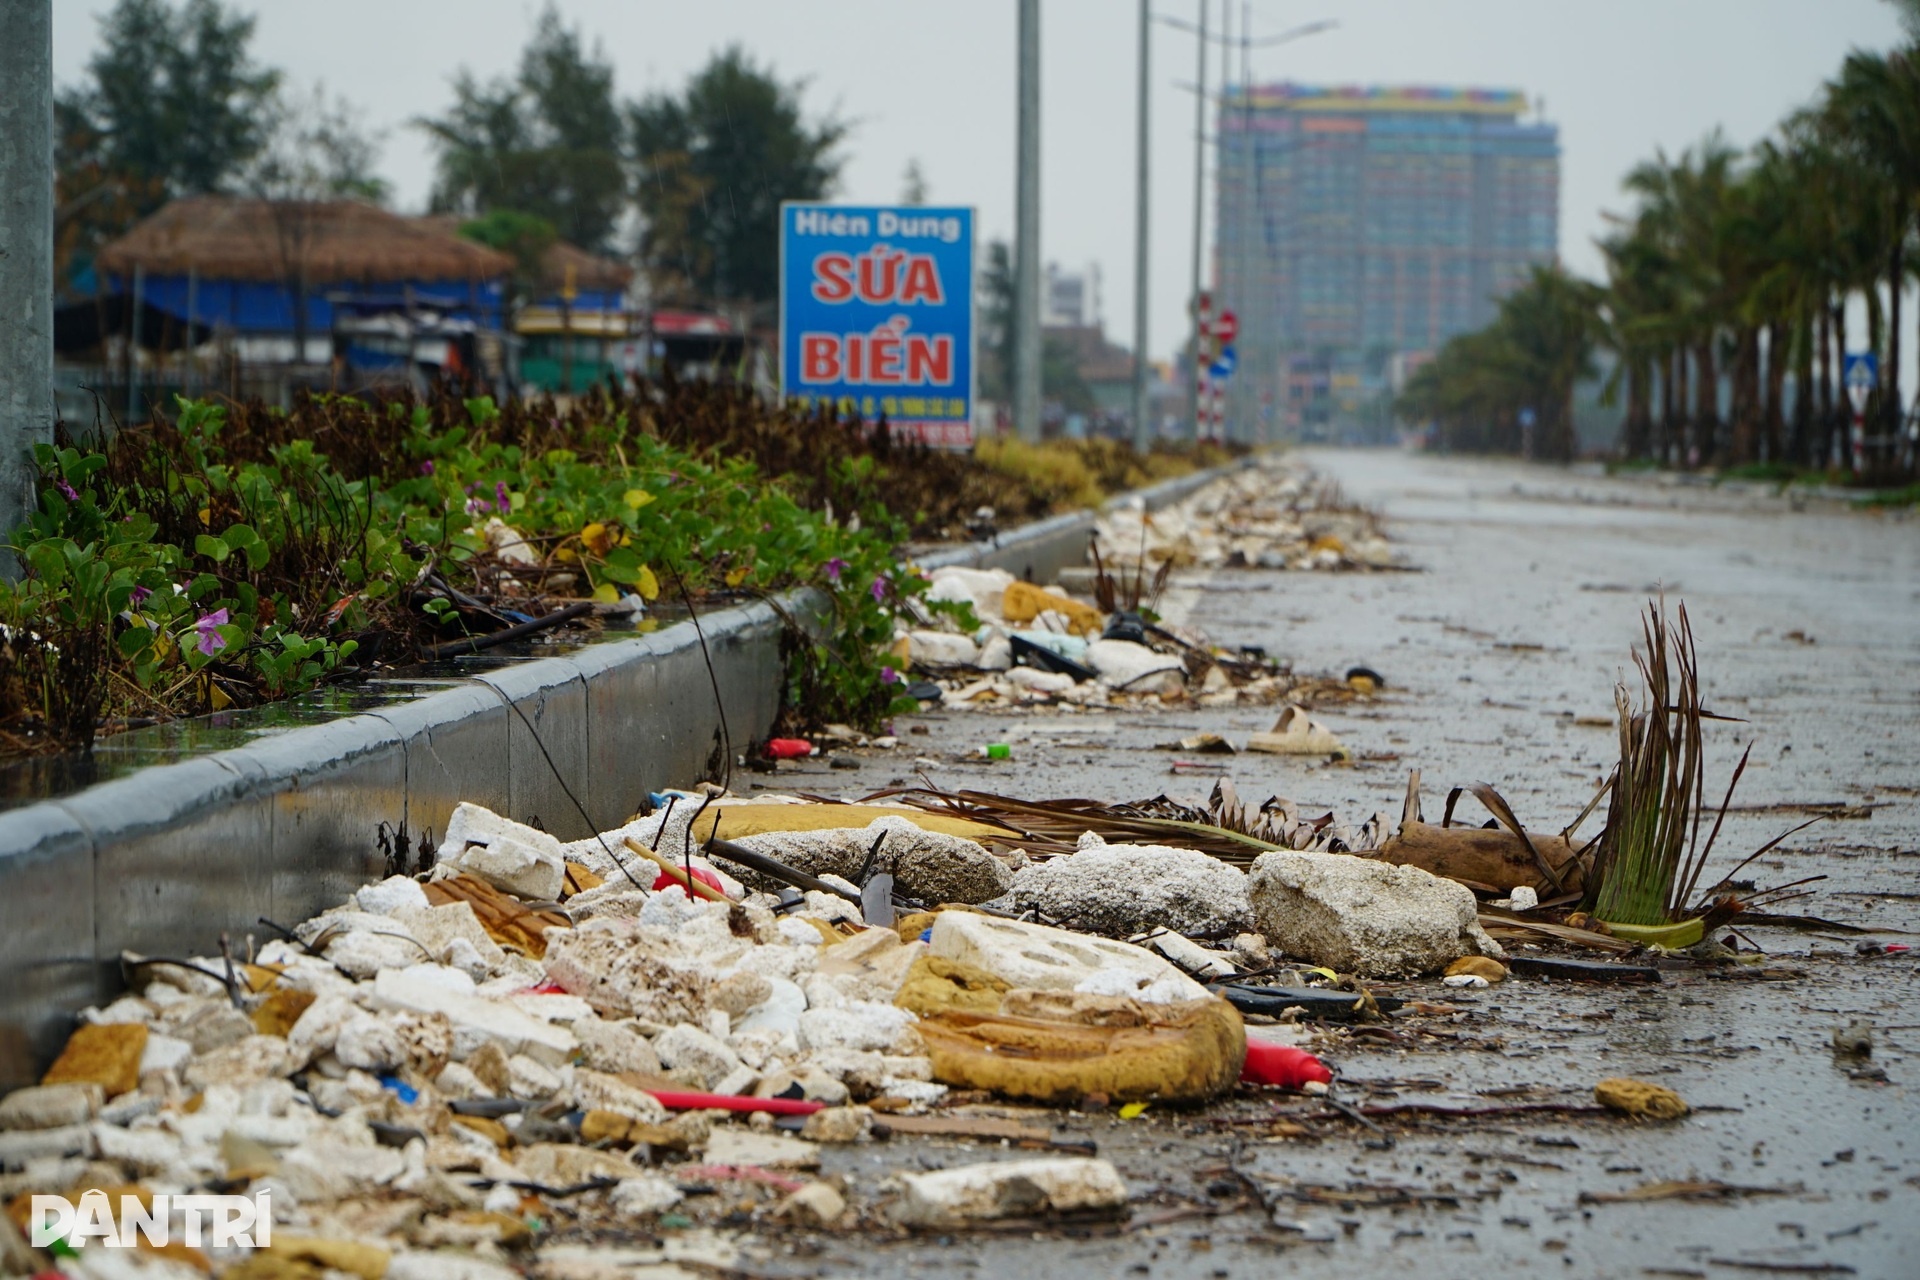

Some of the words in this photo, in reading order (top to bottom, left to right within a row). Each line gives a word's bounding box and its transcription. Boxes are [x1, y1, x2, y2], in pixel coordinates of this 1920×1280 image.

[877, 211, 961, 242] Dung
[812, 244, 945, 304] SỨA
[801, 315, 953, 385] BIỂN
